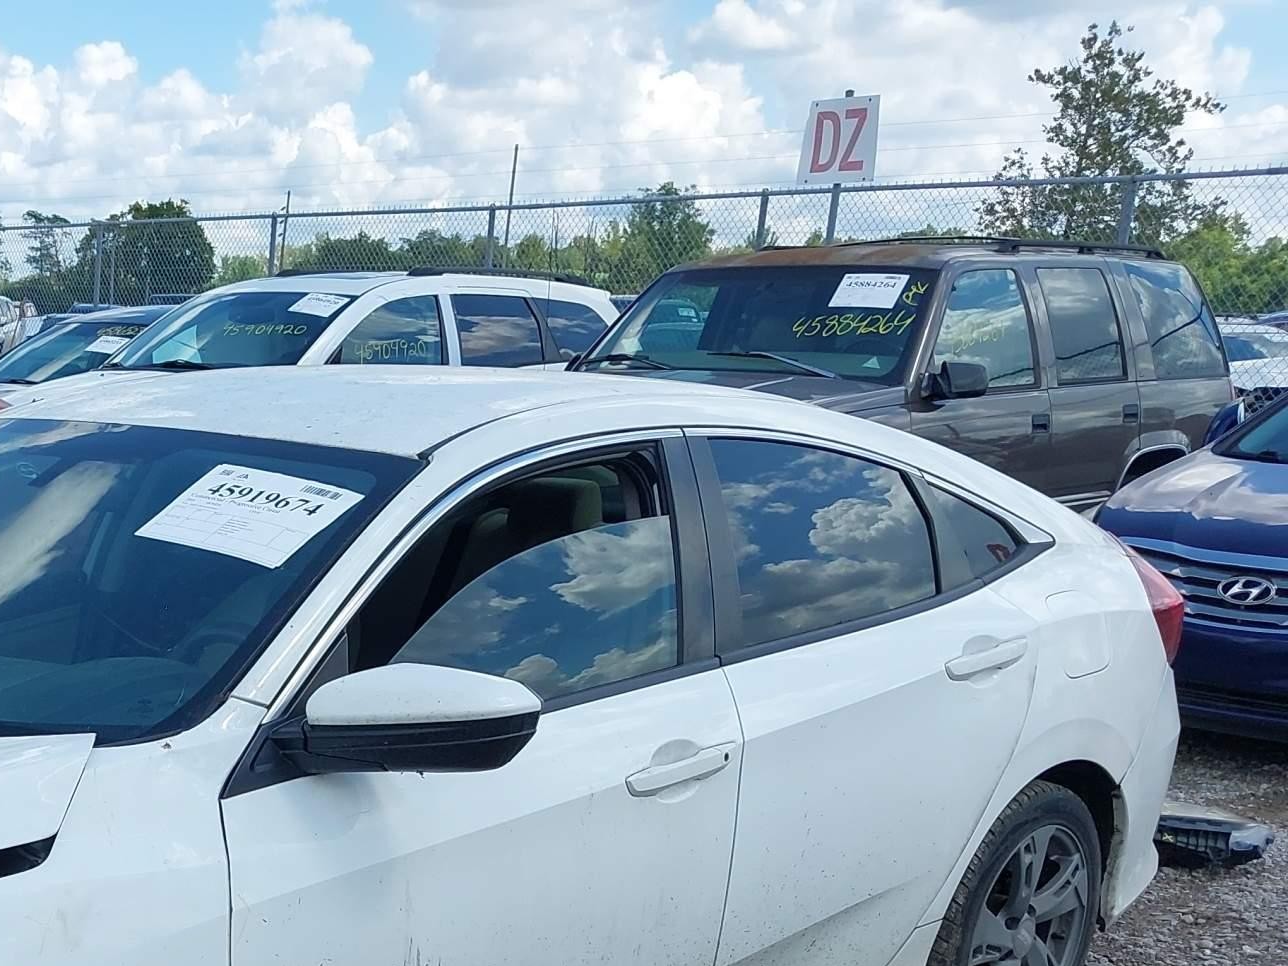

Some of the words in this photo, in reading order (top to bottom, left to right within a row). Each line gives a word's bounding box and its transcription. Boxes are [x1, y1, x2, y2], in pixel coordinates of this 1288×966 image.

[809, 106, 869, 174] DZ
[845, 279, 897, 290] 45884264
[792, 309, 917, 340] 45884264
[355, 339, 427, 366] 45904920
[208, 482, 325, 517] 45919674
